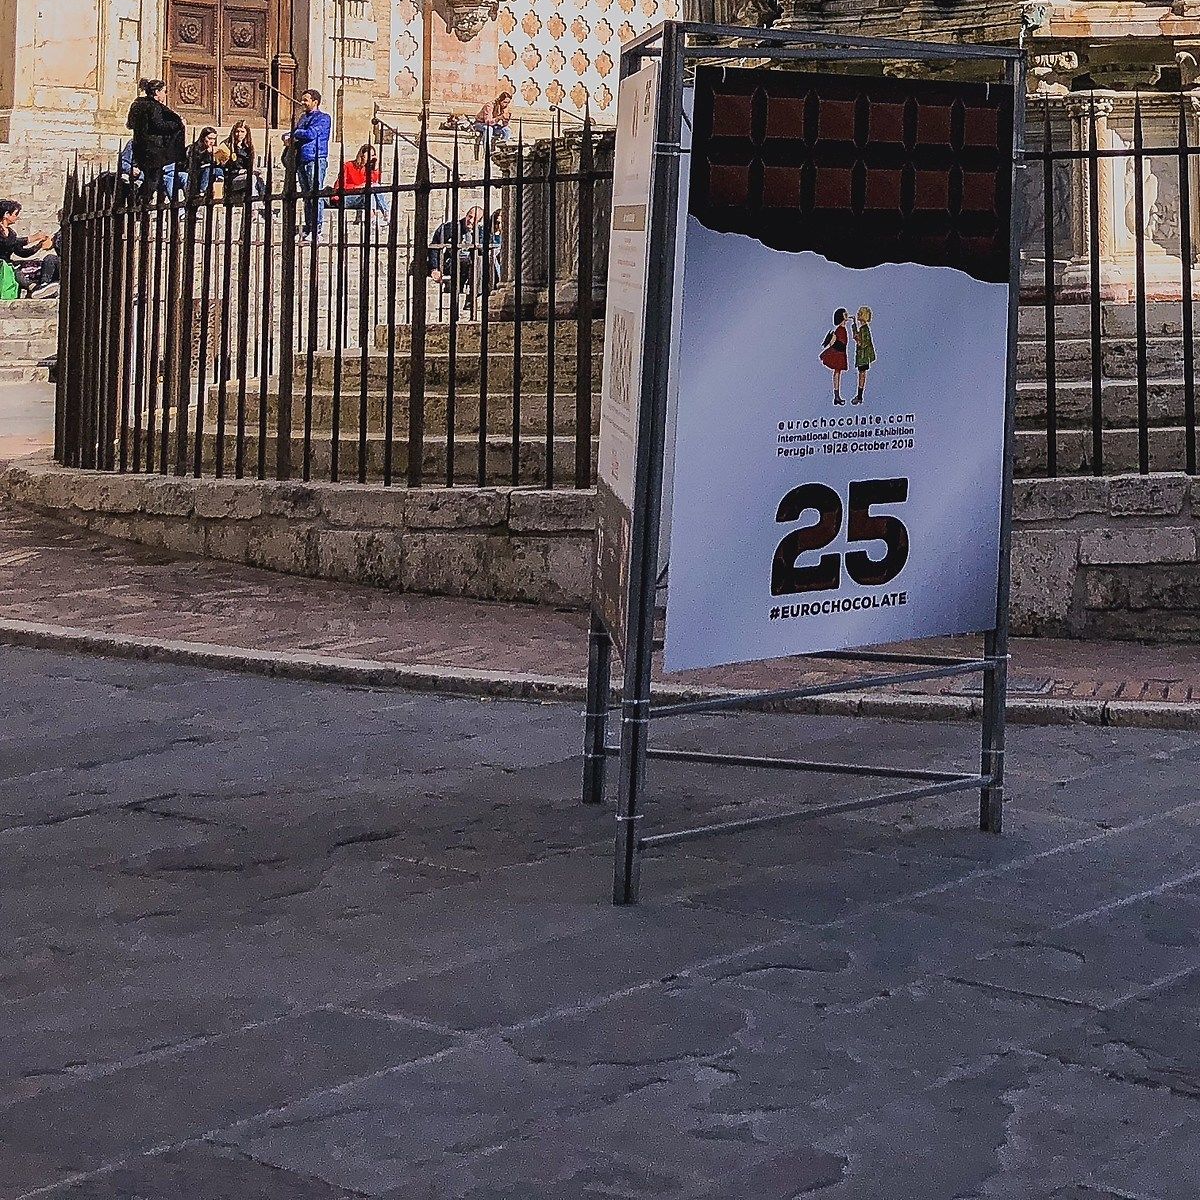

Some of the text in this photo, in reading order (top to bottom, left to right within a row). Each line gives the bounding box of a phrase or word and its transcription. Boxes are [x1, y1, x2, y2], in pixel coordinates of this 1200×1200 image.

[778, 413, 914, 430] eurochocolate.com
[777, 426, 914, 443] International Chocolate Exhibition
[777, 445, 815, 458] Perugia
[850, 441, 890, 452] October
[891, 438, 914, 449] 2018
[770, 477, 910, 596] 25
[769, 591, 907, 620] #EUROCHOCOLATE
